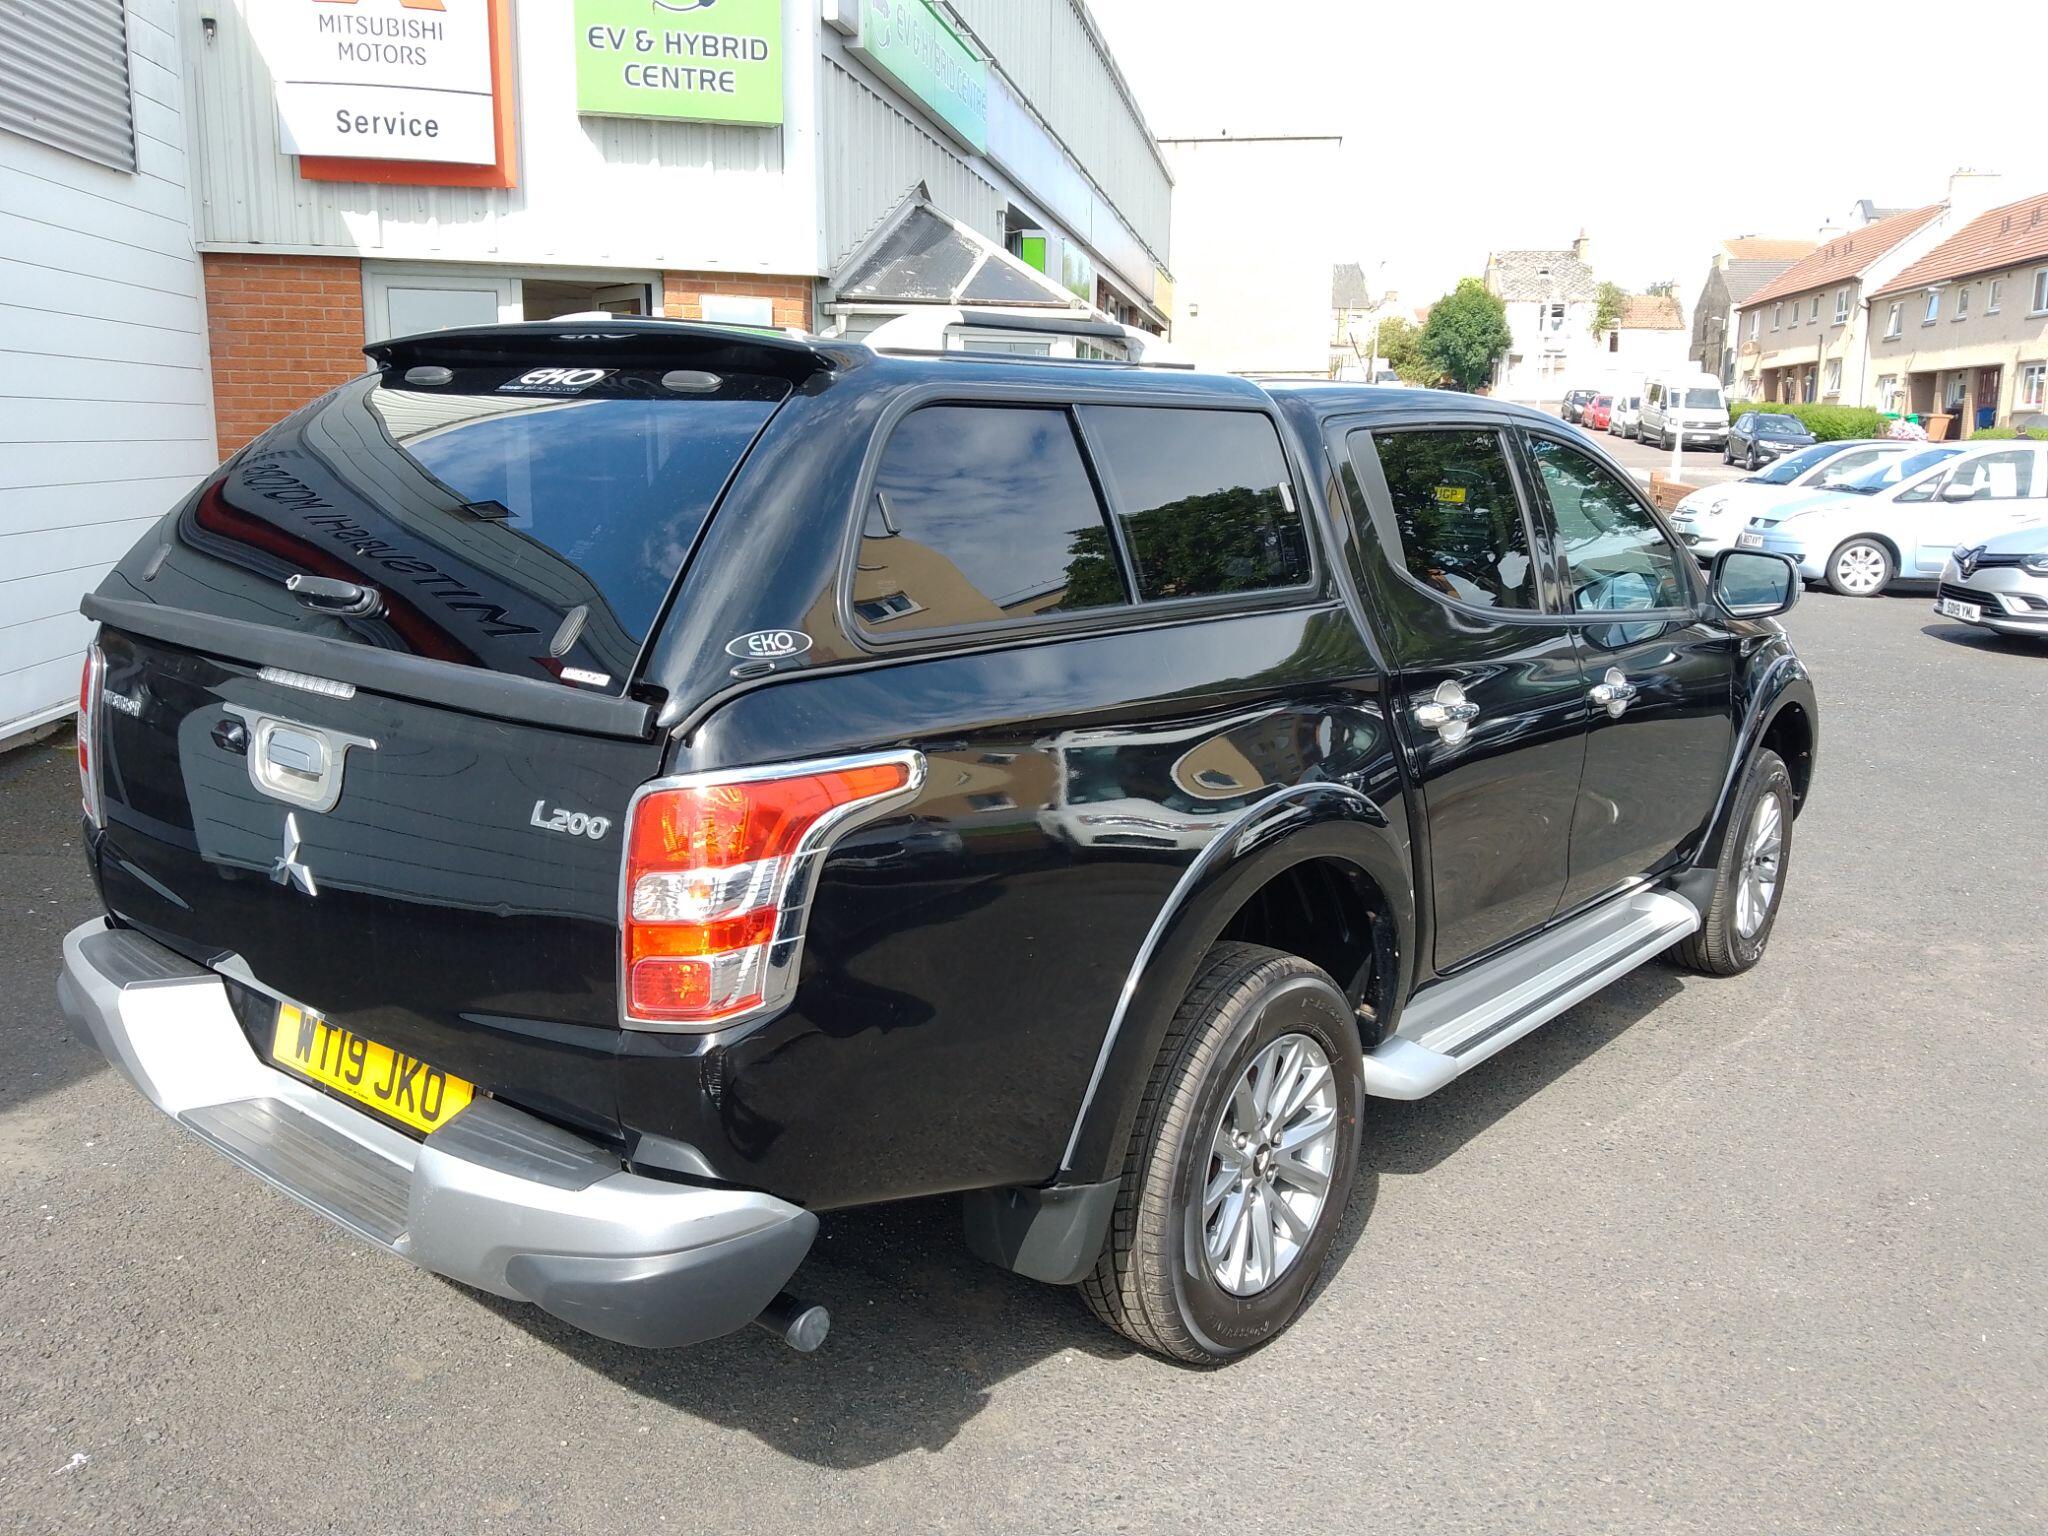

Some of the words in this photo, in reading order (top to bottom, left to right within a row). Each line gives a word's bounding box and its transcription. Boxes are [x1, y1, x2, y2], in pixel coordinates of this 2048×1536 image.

[319, 14, 444, 41] MITSUBISHI
[338, 42, 427, 66] MOTORS
[588, 26, 626, 50] EV
[635, 30, 655, 52] &
[665, 31, 768, 61] HYBRID
[897, 4, 911, 46] EV
[921, 26, 955, 93] HYBRID
[624, 64, 734, 93] CENTRE
[336, 109, 439, 138] Service
[520, 368, 606, 386] EKO
[748, 632, 794, 651] EKO
[530, 800, 611, 840] L200
[296, 1011, 368, 1086] WT19
